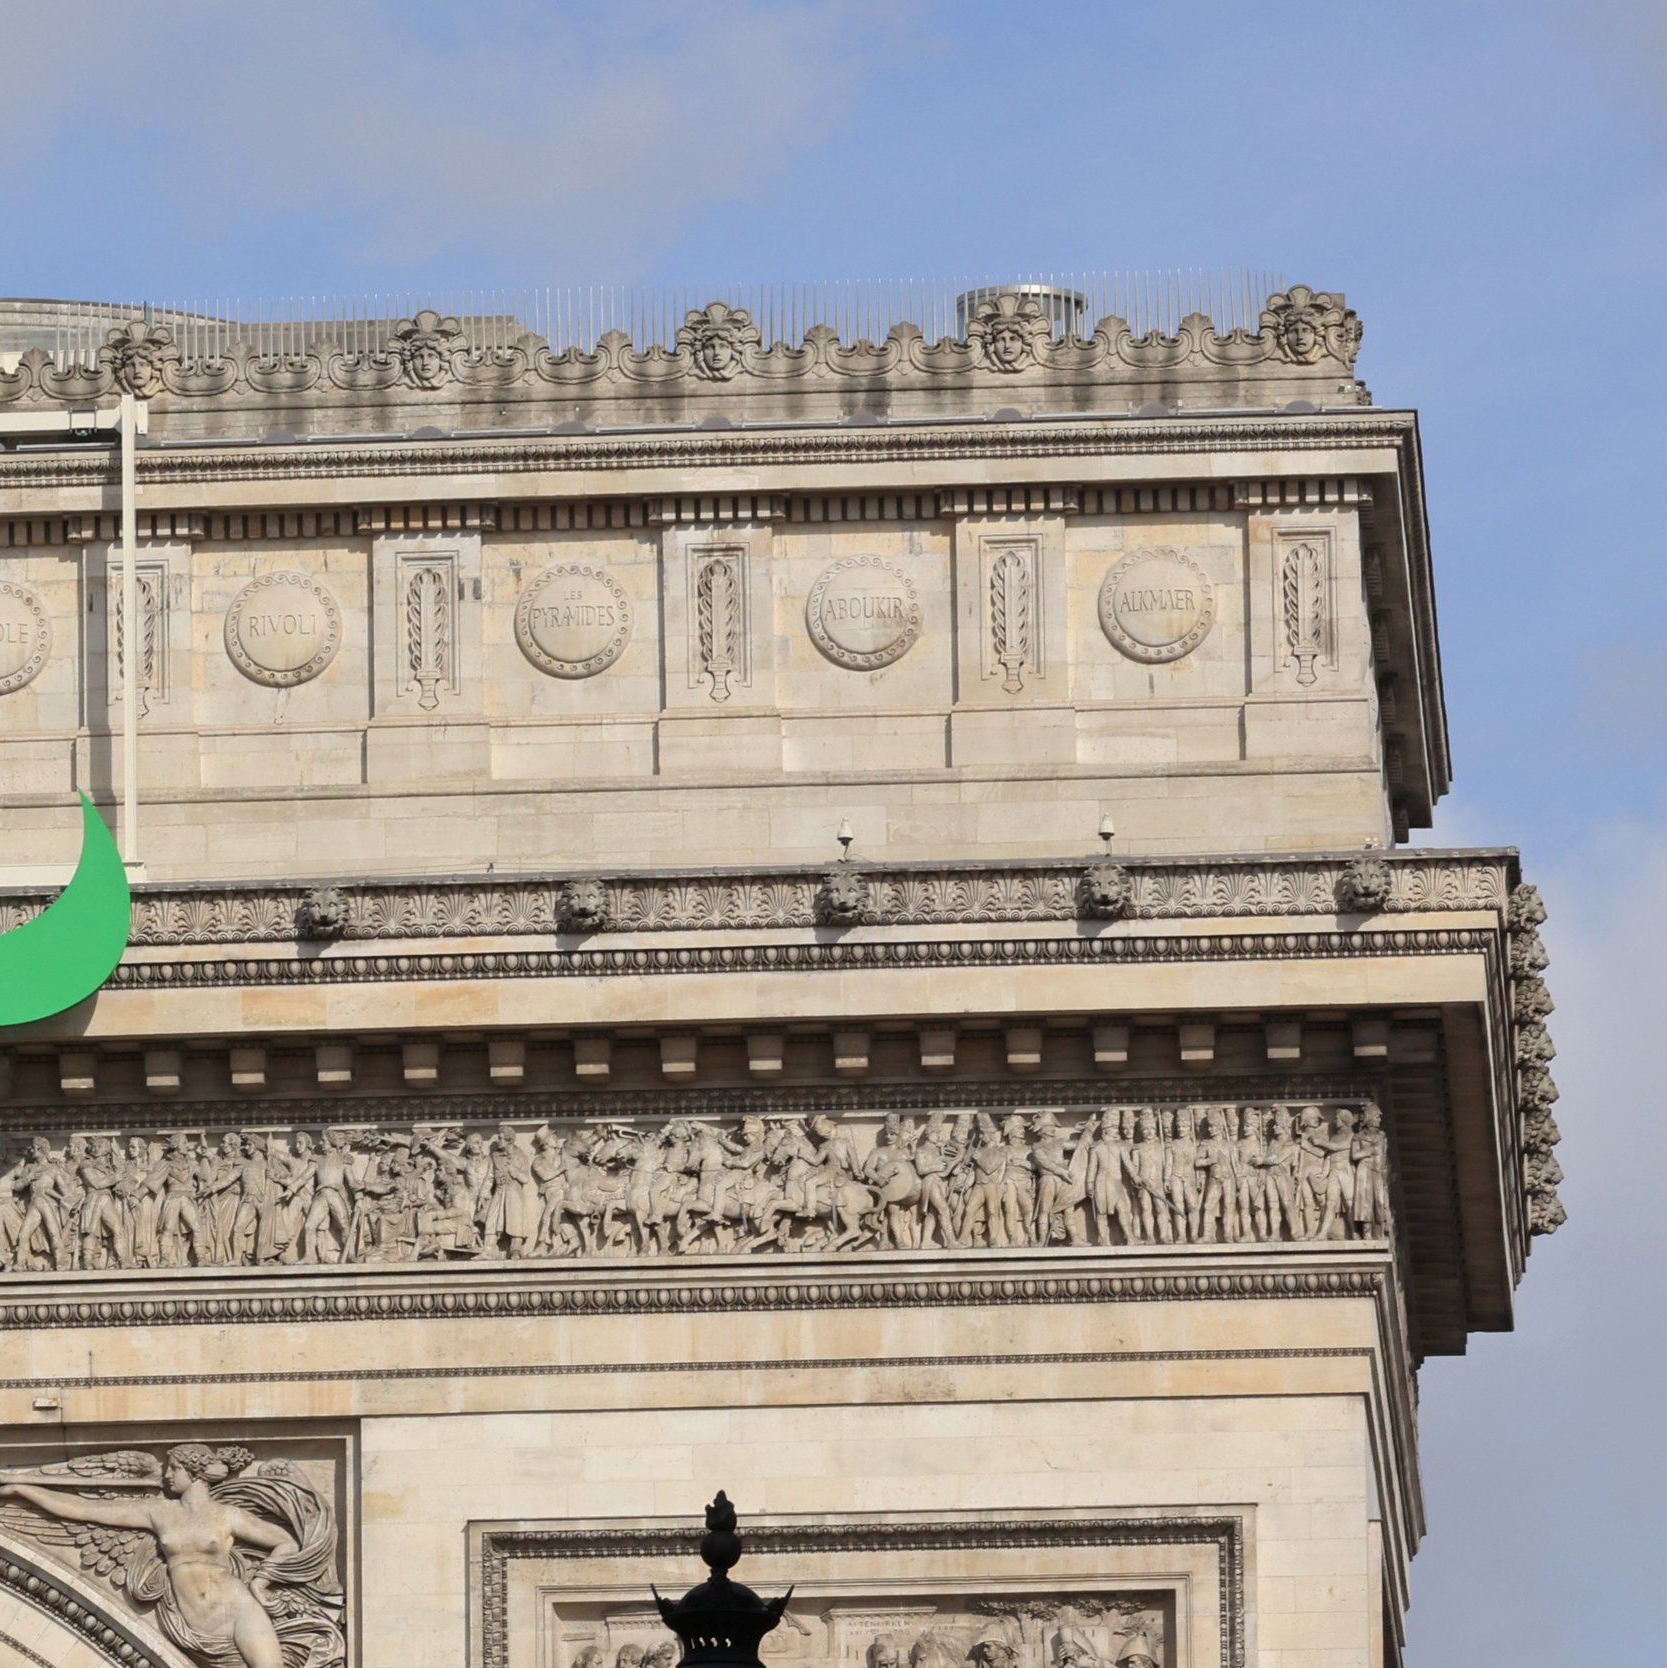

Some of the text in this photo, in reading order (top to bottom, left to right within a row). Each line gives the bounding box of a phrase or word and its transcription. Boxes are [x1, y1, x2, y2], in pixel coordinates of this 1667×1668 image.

[563, 591, 584, 600] LES
[1120, 589, 1196, 614] ALKMAER
[532, 605, 616, 629] PYRAMIDES
[824, 597, 904, 621] ABOUKIR
[249, 614, 316, 637] RIVOLI
